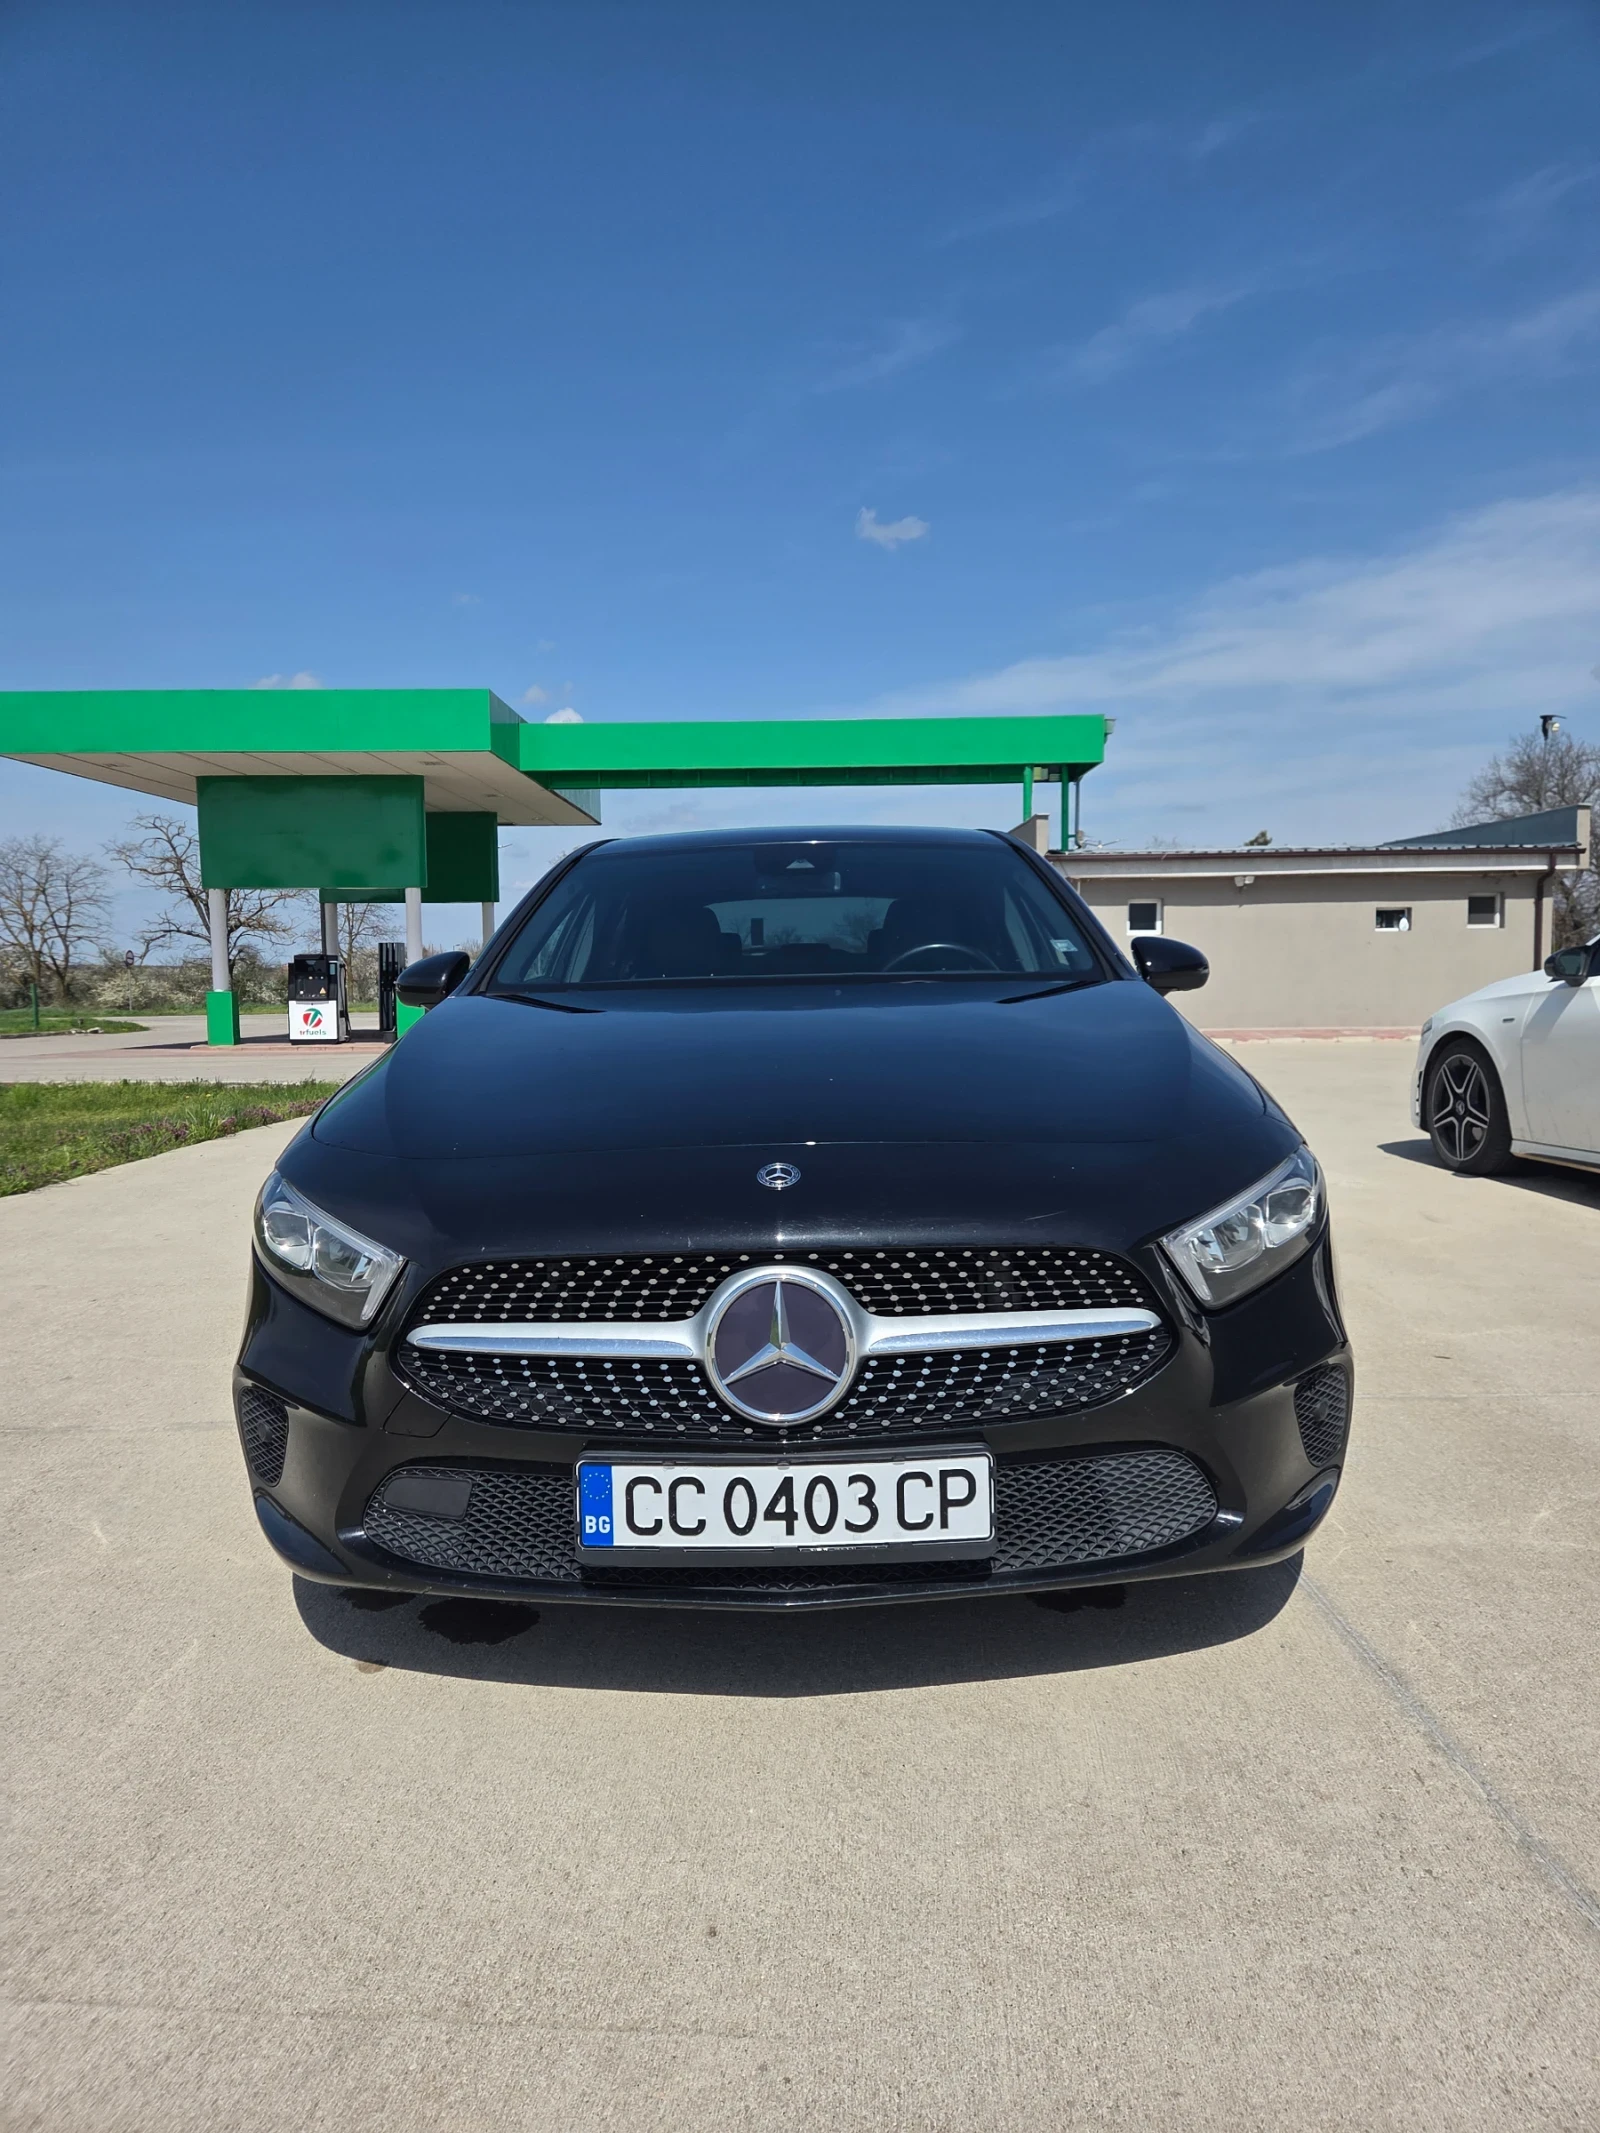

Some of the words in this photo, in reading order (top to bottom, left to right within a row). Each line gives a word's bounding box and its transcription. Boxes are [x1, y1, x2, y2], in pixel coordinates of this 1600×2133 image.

[625, 1476, 707, 1536] CC
[723, 1474, 879, 1536] 0403
[896, 1468, 977, 1531] CP
[585, 1515, 611, 1534] BG
